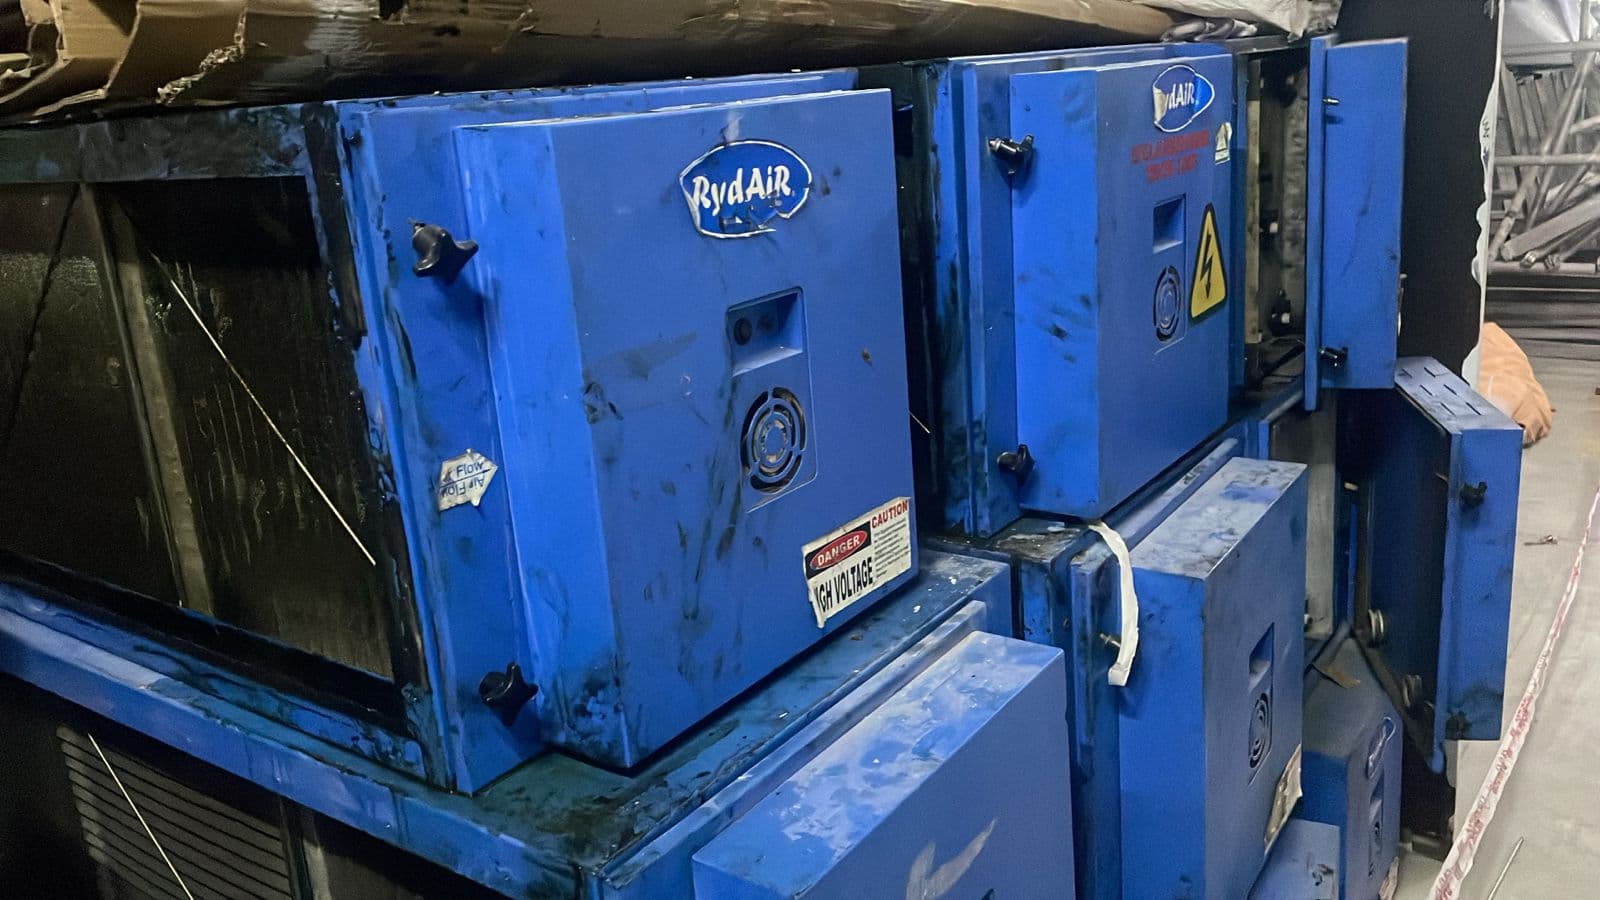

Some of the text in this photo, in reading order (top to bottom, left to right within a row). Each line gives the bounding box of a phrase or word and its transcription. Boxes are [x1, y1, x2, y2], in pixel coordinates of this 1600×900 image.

[871, 499, 908, 528] CAUTION
[817, 534, 860, 567] DANGER
[814, 557, 873, 612] IGH VOLTAGE
